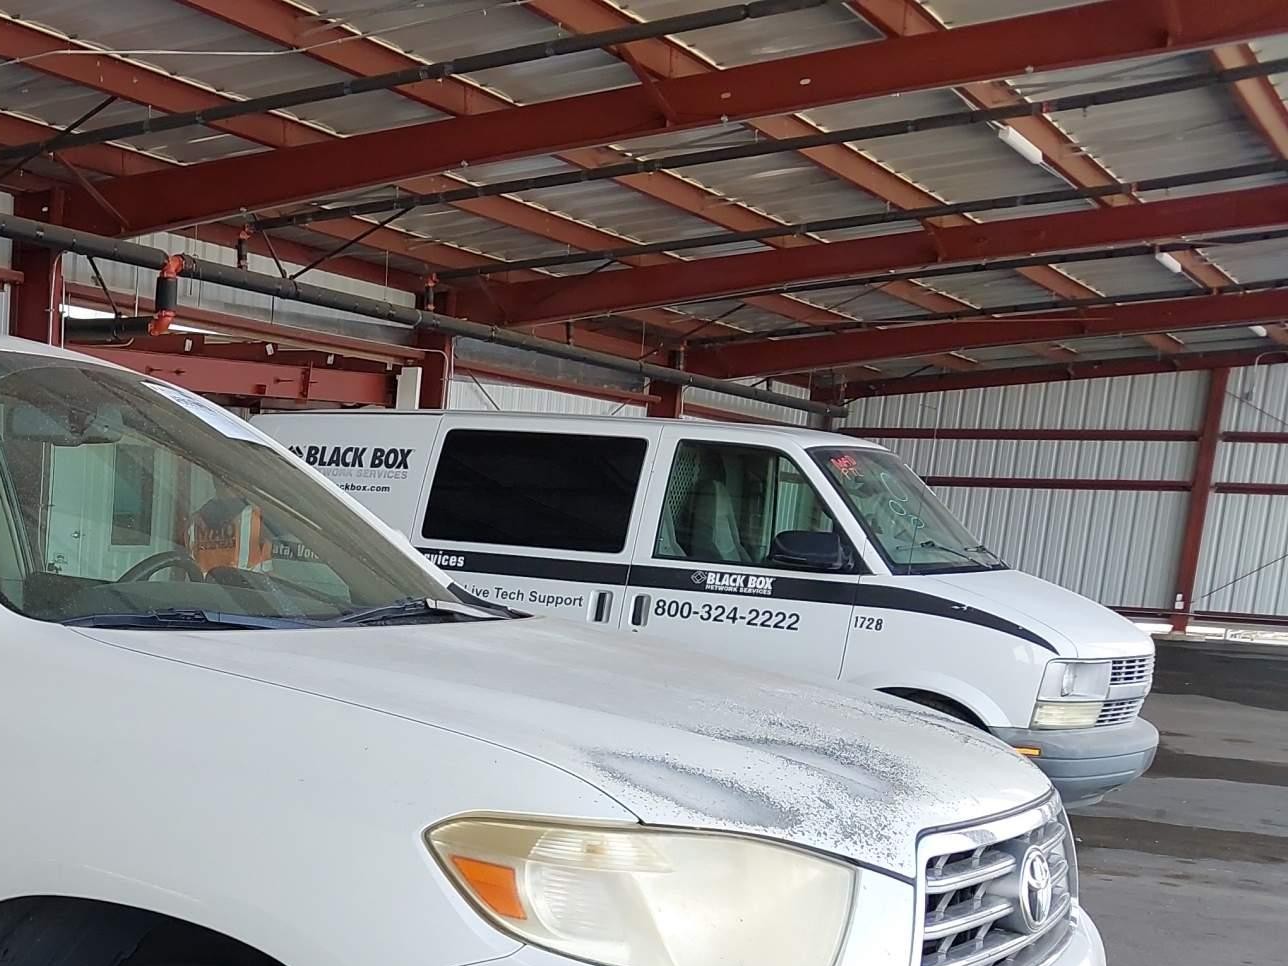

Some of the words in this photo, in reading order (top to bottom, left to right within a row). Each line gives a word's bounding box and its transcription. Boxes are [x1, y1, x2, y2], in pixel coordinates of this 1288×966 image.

[305, 445, 368, 468] BLACK
[370, 447, 413, 470] BOX
[355, 469, 409, 480] SERVICES
[705, 584, 738, 593] NETWORK
[739, 587, 772, 596] SERVICES
[706, 572, 747, 588] BLACK
[747, 576, 775, 590] BOX
[494, 586, 525, 601] Tech
[528, 590, 584, 608] Support
[654, 599, 801, 632] 800-324-2222
[854, 615, 884, 632] 1728
